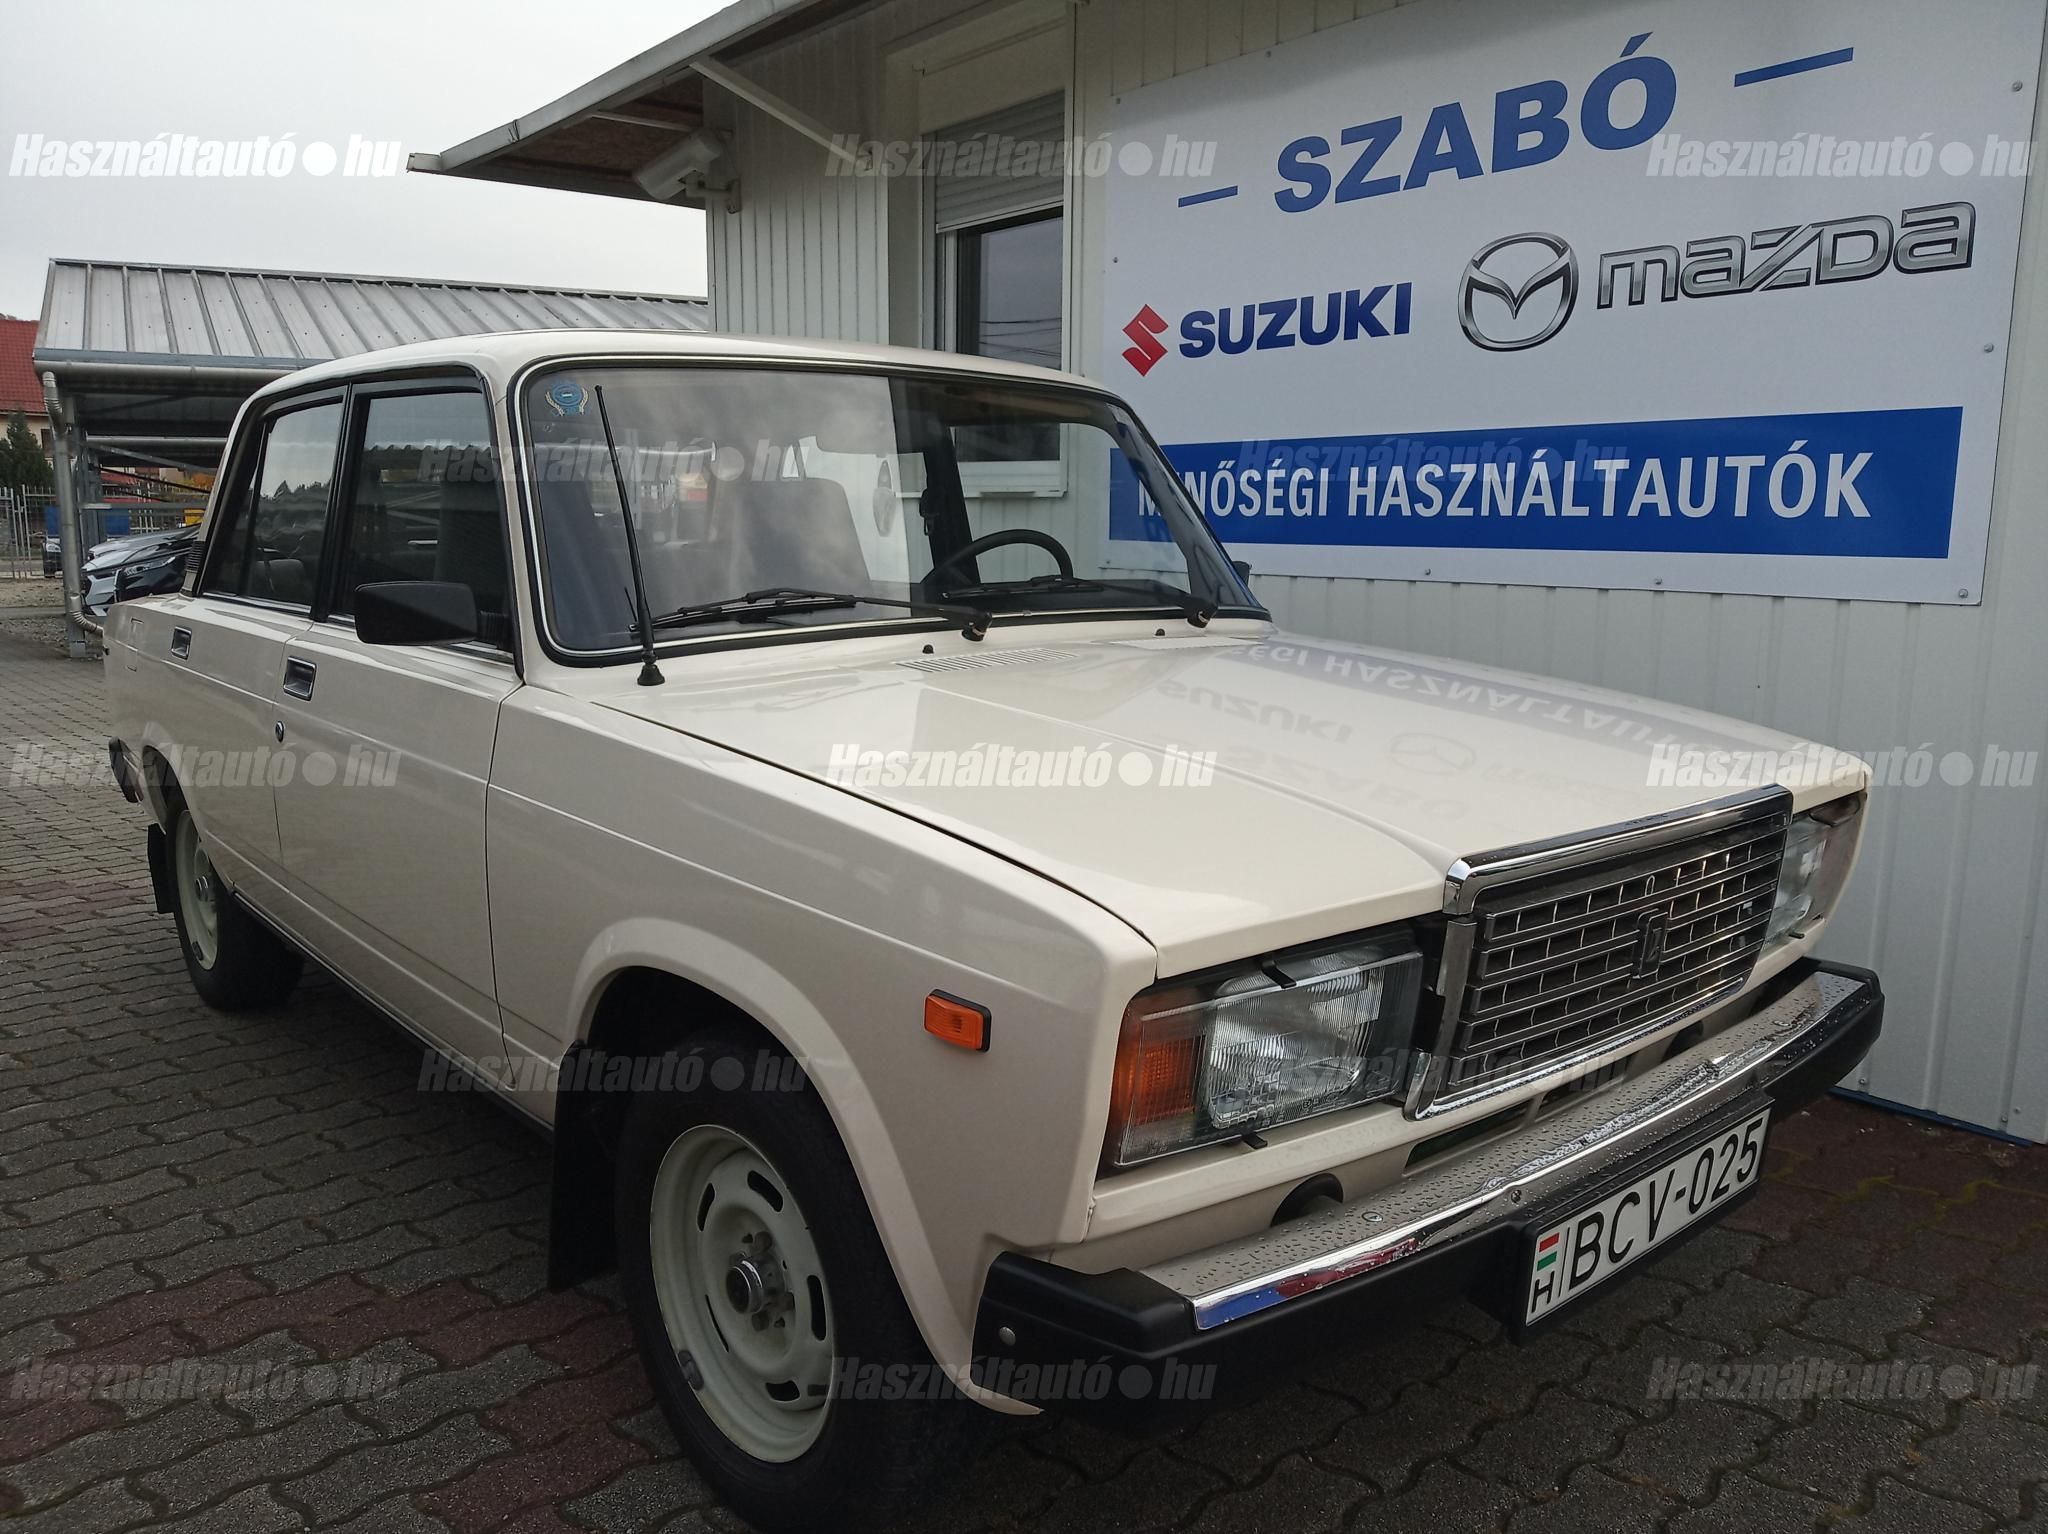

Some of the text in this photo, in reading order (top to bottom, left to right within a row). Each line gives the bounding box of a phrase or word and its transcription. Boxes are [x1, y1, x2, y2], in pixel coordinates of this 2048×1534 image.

[1274, 32, 1678, 213] SZABÓ
[1179, 282, 1412, 359] SUZUKI
[1139, 441, 1873, 518] MNŐSÉGI HASZNÁLTAUTÓK
[1569, 1117, 1763, 1290] BCV-025
[1531, 1270, 1556, 1314] H
